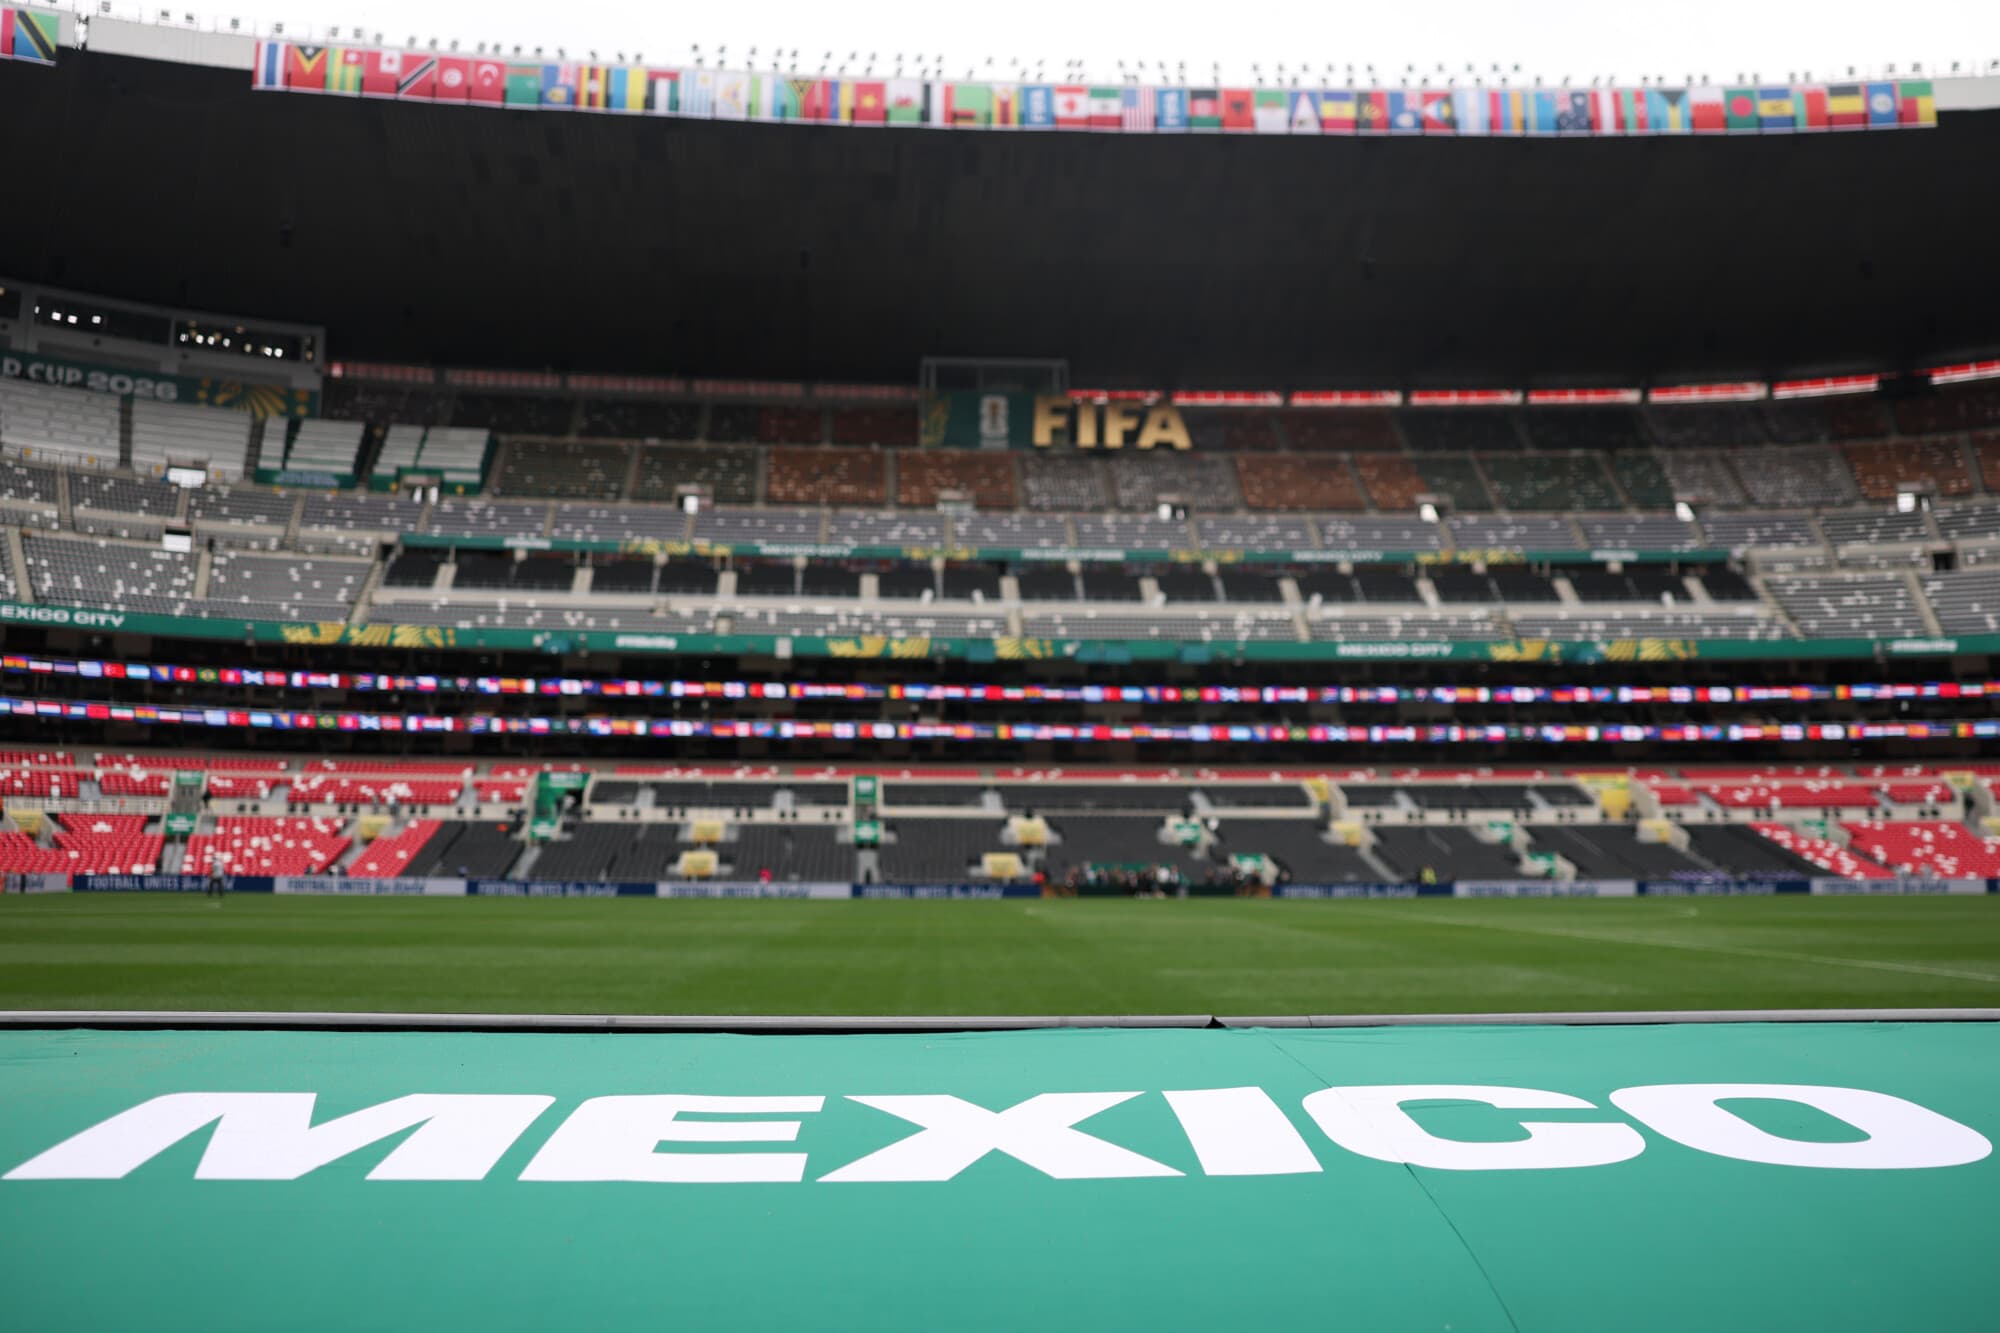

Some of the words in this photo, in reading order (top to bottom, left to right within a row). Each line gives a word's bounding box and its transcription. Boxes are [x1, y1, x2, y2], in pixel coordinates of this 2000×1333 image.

[28, 362, 82, 385] CUP
[87, 371, 177, 400] 2026
[1033, 395, 1192, 449] FIFA
[73, 611, 125, 627] CITY
[1, 1084, 1993, 1183] MEXICO
